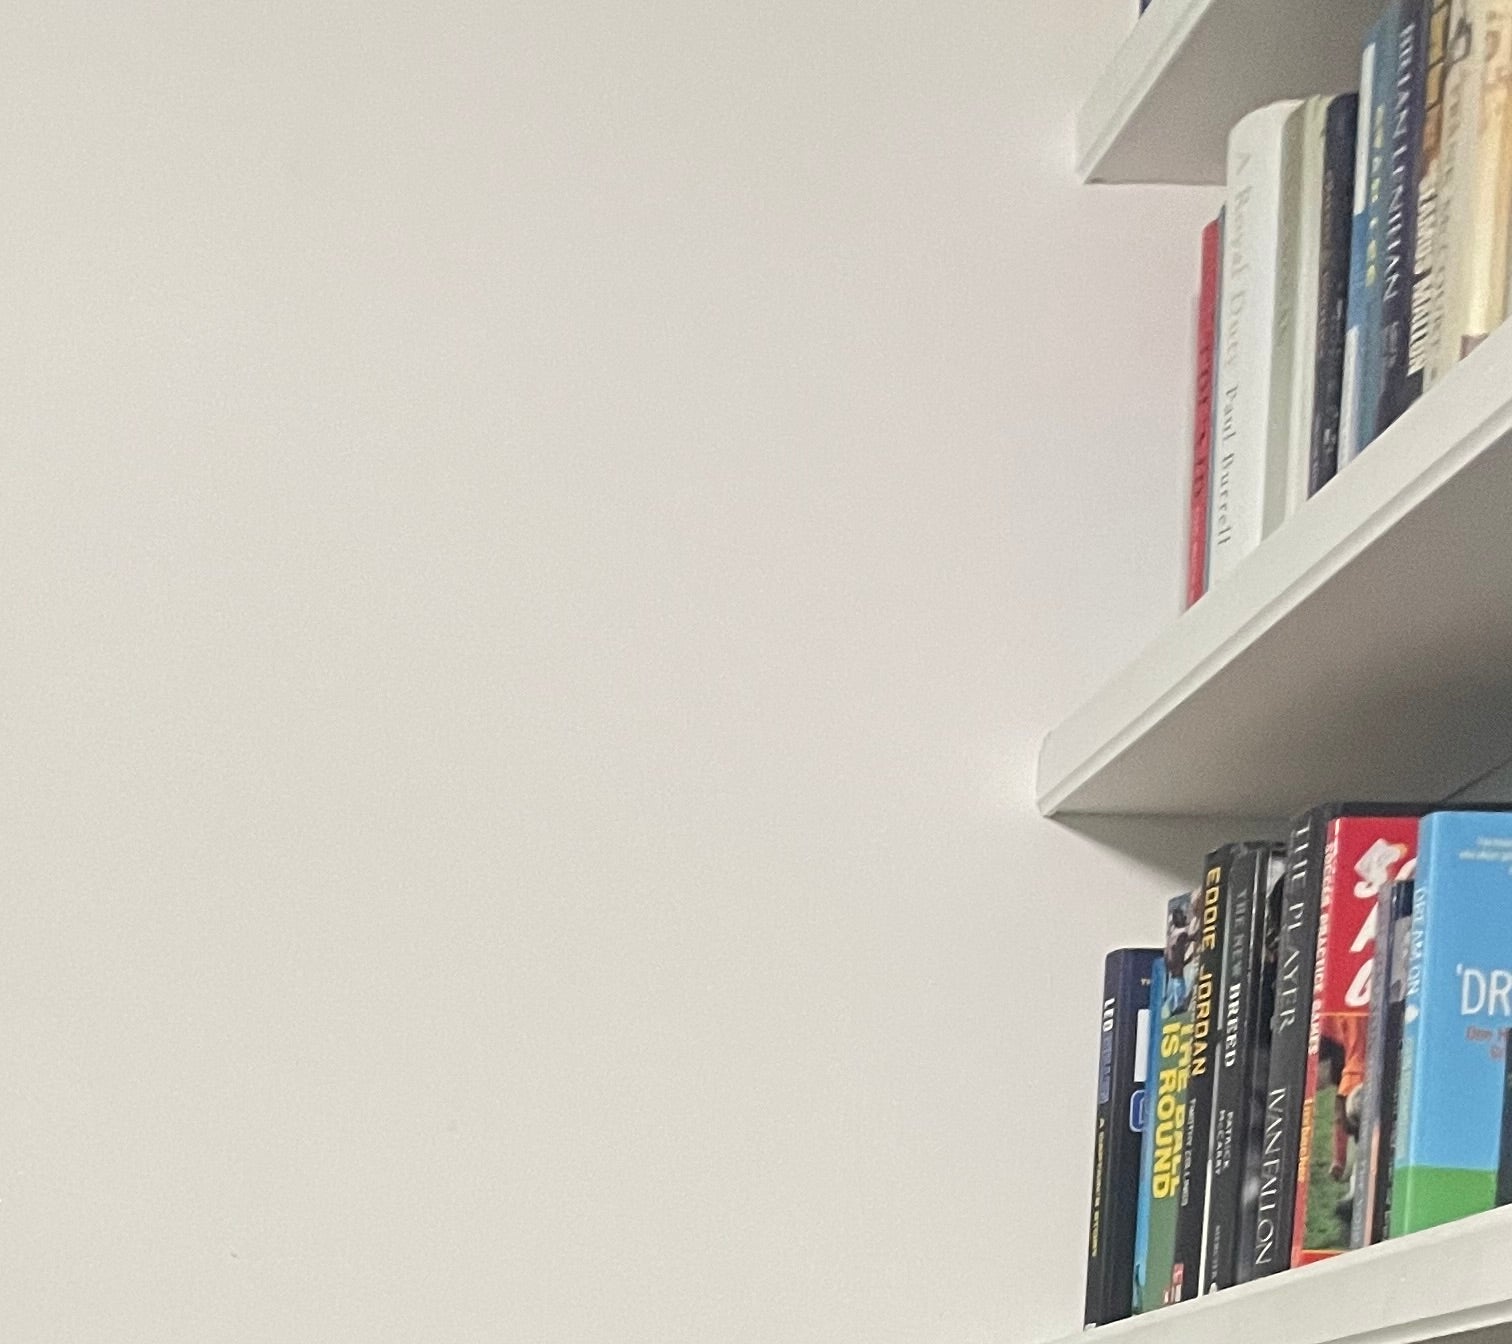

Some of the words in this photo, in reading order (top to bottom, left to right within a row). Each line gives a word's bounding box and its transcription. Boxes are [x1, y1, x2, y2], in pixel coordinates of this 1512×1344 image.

[1291, 822, 1309, 885] THE
[1200, 866, 1221, 951] EDDIE
[1278, 902, 1304, 1034] PLAYER
[1161, 1022, 1180, 1059] IS
[1191, 969, 1212, 1077] JORDAN
[1225, 983, 1242, 1069] BREED
[1153, 1071, 1176, 1201] ROUND
